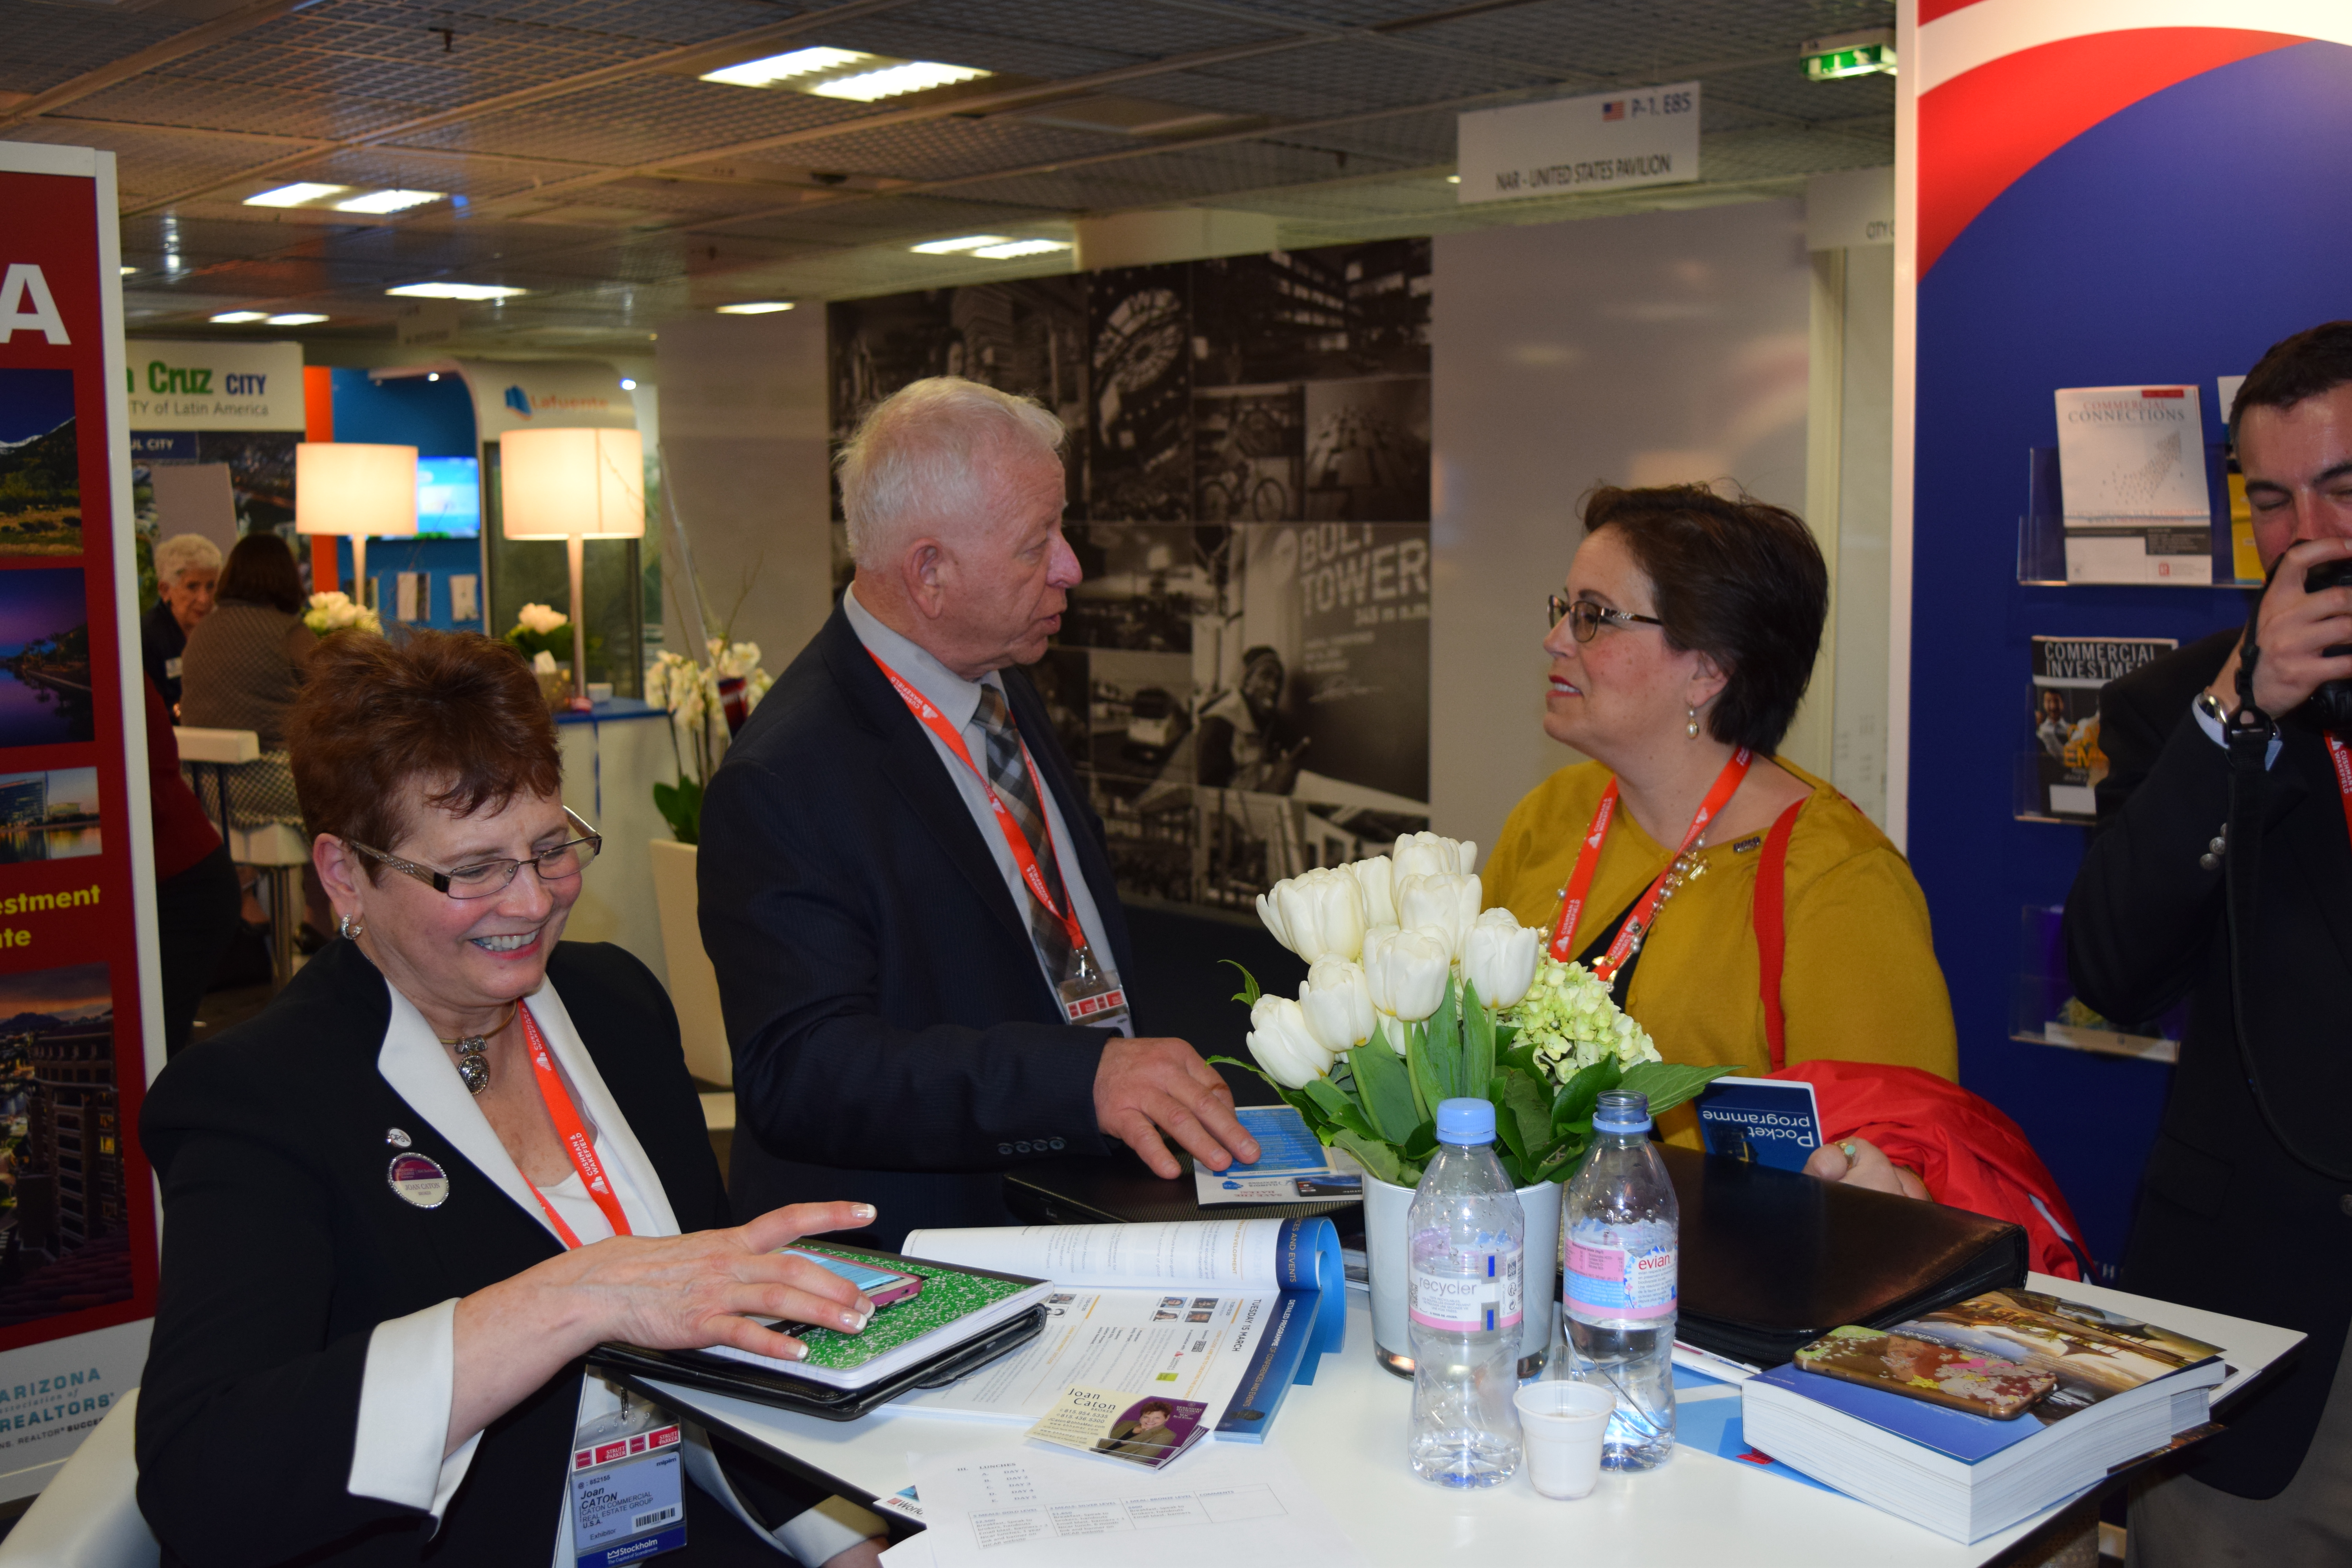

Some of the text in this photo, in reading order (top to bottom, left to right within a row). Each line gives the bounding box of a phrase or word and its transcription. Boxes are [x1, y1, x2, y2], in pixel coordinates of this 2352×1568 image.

[1528, 164, 1572, 188] UNITED
[1575, 160, 1614, 183] STATES
[1616, 153, 1671, 178] PAVILION
[147, 361, 214, 394] Cruz
[225, 374, 267, 395] CITY
[154, 401, 169, 416] of
[175, 401, 209, 416] Latin
[214, 401, 269, 416] America
[2083, 399, 2167, 411] COMMERCIAL
[2068, 408, 2185, 423] CONNECTIONS
[147, 438, 174, 451] CITY
[1299, 538, 1429, 617] TOWER
[891, 677, 923, 706] WAKEFIELD
[2334, 751, 2349, 794] WAKEFIELD
[1561, 904, 1573, 935] CUSHMAN
[1566, 899, 1580, 935] WAKEFIELD
[1702, 1110, 1810, 1127] programme
[1748, 1126, 1815, 1147] Pocket
[573, 1142, 593, 1176] CUSHMAN
[576, 1132, 599, 1174] WAKEFIELD
[1232, 1231, 1240, 1274] DEVELOPMENT
[1288, 1252, 1296, 1283] EVENTS
[1638, 1254, 1670, 1270] evian
[1419, 1277, 1477, 1296] recycler
[1245, 1299, 1262, 1324] TUESDAY
[1283, 1299, 1296, 1319] DETAILED
[1232, 1331, 1248, 1352] MARCH
[1271, 1319, 1288, 1347] PROGRAMME
[1197, 1341, 1206, 1352] ESTATES
[1255, 1354, 1274, 1383] CONFERENCES
[0, 1368, 101, 1403] ARIZONA
[1068, 1388, 1100, 1399] Joan
[1074, 1398, 1116, 1410] Caton
[1243, 1391, 1256, 1407] EVENTS
[1060, 1414, 1105, 1423] 815.436.5300
[1064, 1408, 1109, 1418] 815.954.5335
[659, 1431, 677, 1440] STRUTT
[606, 1445, 625, 1454] STRUTT
[656, 1456, 677, 1466] mipim
[590, 1475, 611, 1485] 852155
[581, 1487, 604, 1500] Joan
[582, 1492, 618, 1509] CATON
[582, 1491, 652, 1516] CATON COMMERCIAL
[583, 1497, 653, 1523] REAL ESTATE GROUP
[583, 1519, 603, 1528] U.S.A.
[590, 1528, 617, 1540] Exhibitor
[615, 1555, 630, 1563] Capital
[634, 1546, 658, 1557] Scandinavia
[620, 1539, 658, 1556] Stockholm
